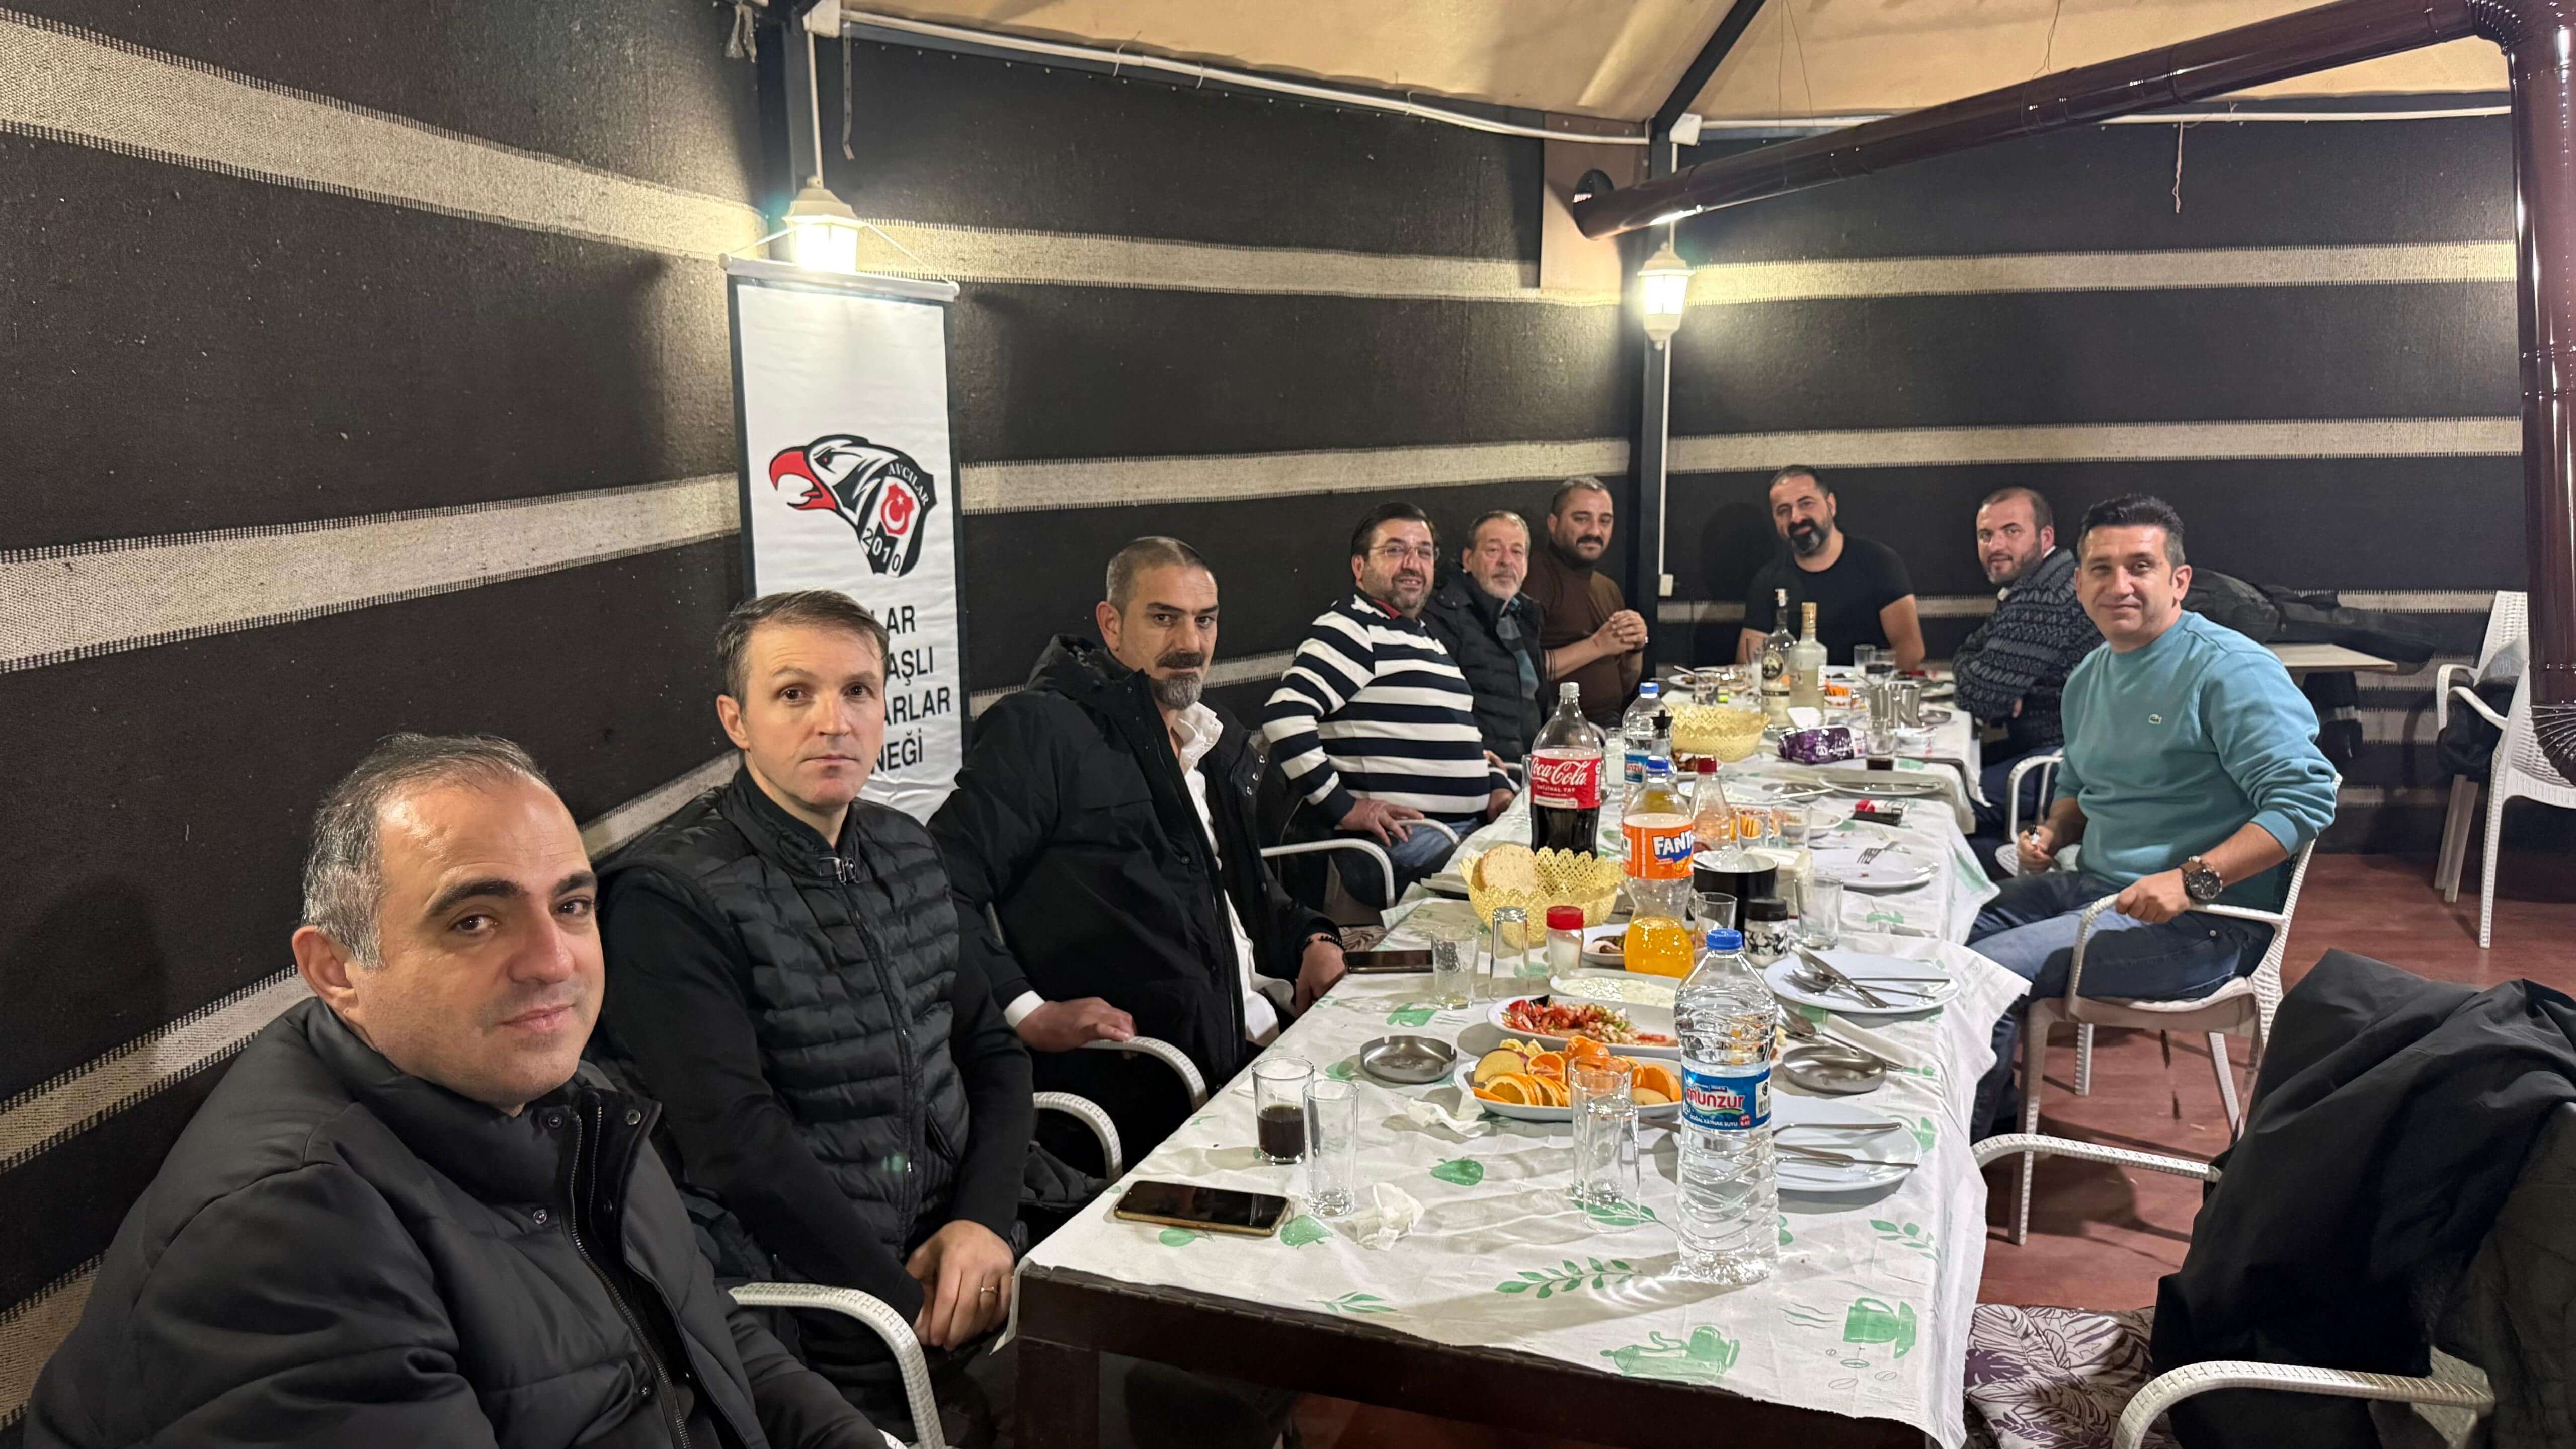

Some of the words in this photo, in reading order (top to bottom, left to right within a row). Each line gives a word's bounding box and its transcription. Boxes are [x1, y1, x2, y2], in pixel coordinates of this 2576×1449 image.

[888, 462, 929, 506] AVCILAR
[862, 528, 901, 572] 2010
[1531, 757, 1591, 785] Coca-Cola
